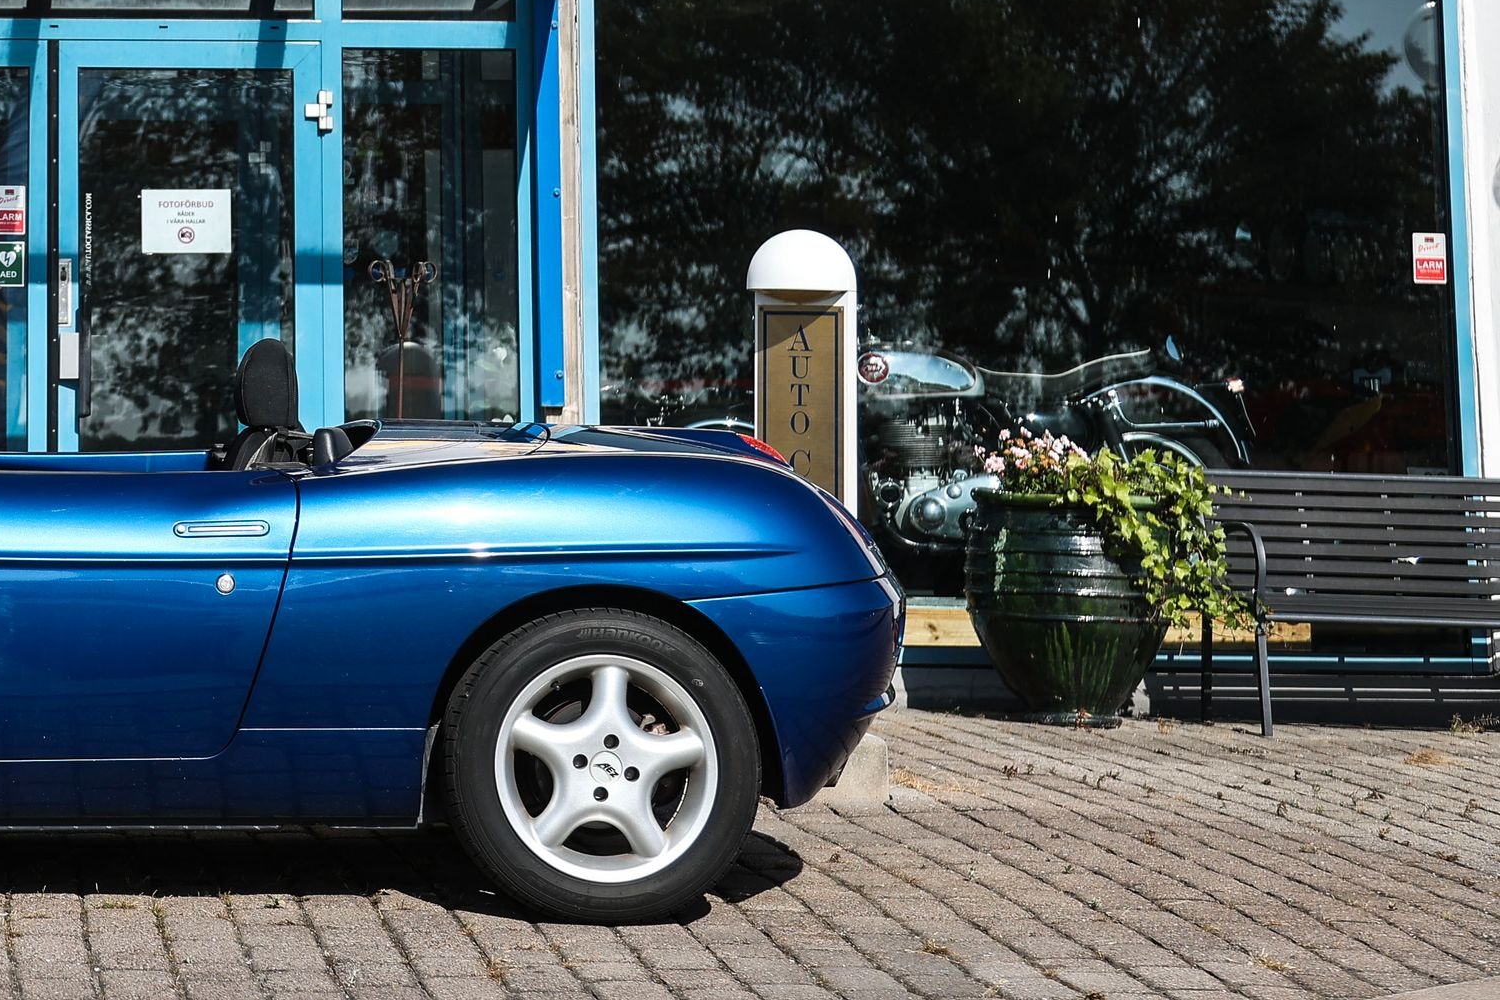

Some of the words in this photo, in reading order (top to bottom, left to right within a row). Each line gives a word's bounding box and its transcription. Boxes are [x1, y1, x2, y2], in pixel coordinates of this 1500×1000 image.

[158, 200, 214, 208] FOTOFÖRBUD
[1417, 261, 1443, 270] LARM
[0, 270, 17, 278] AED
[788, 323, 813, 435] AUTO
